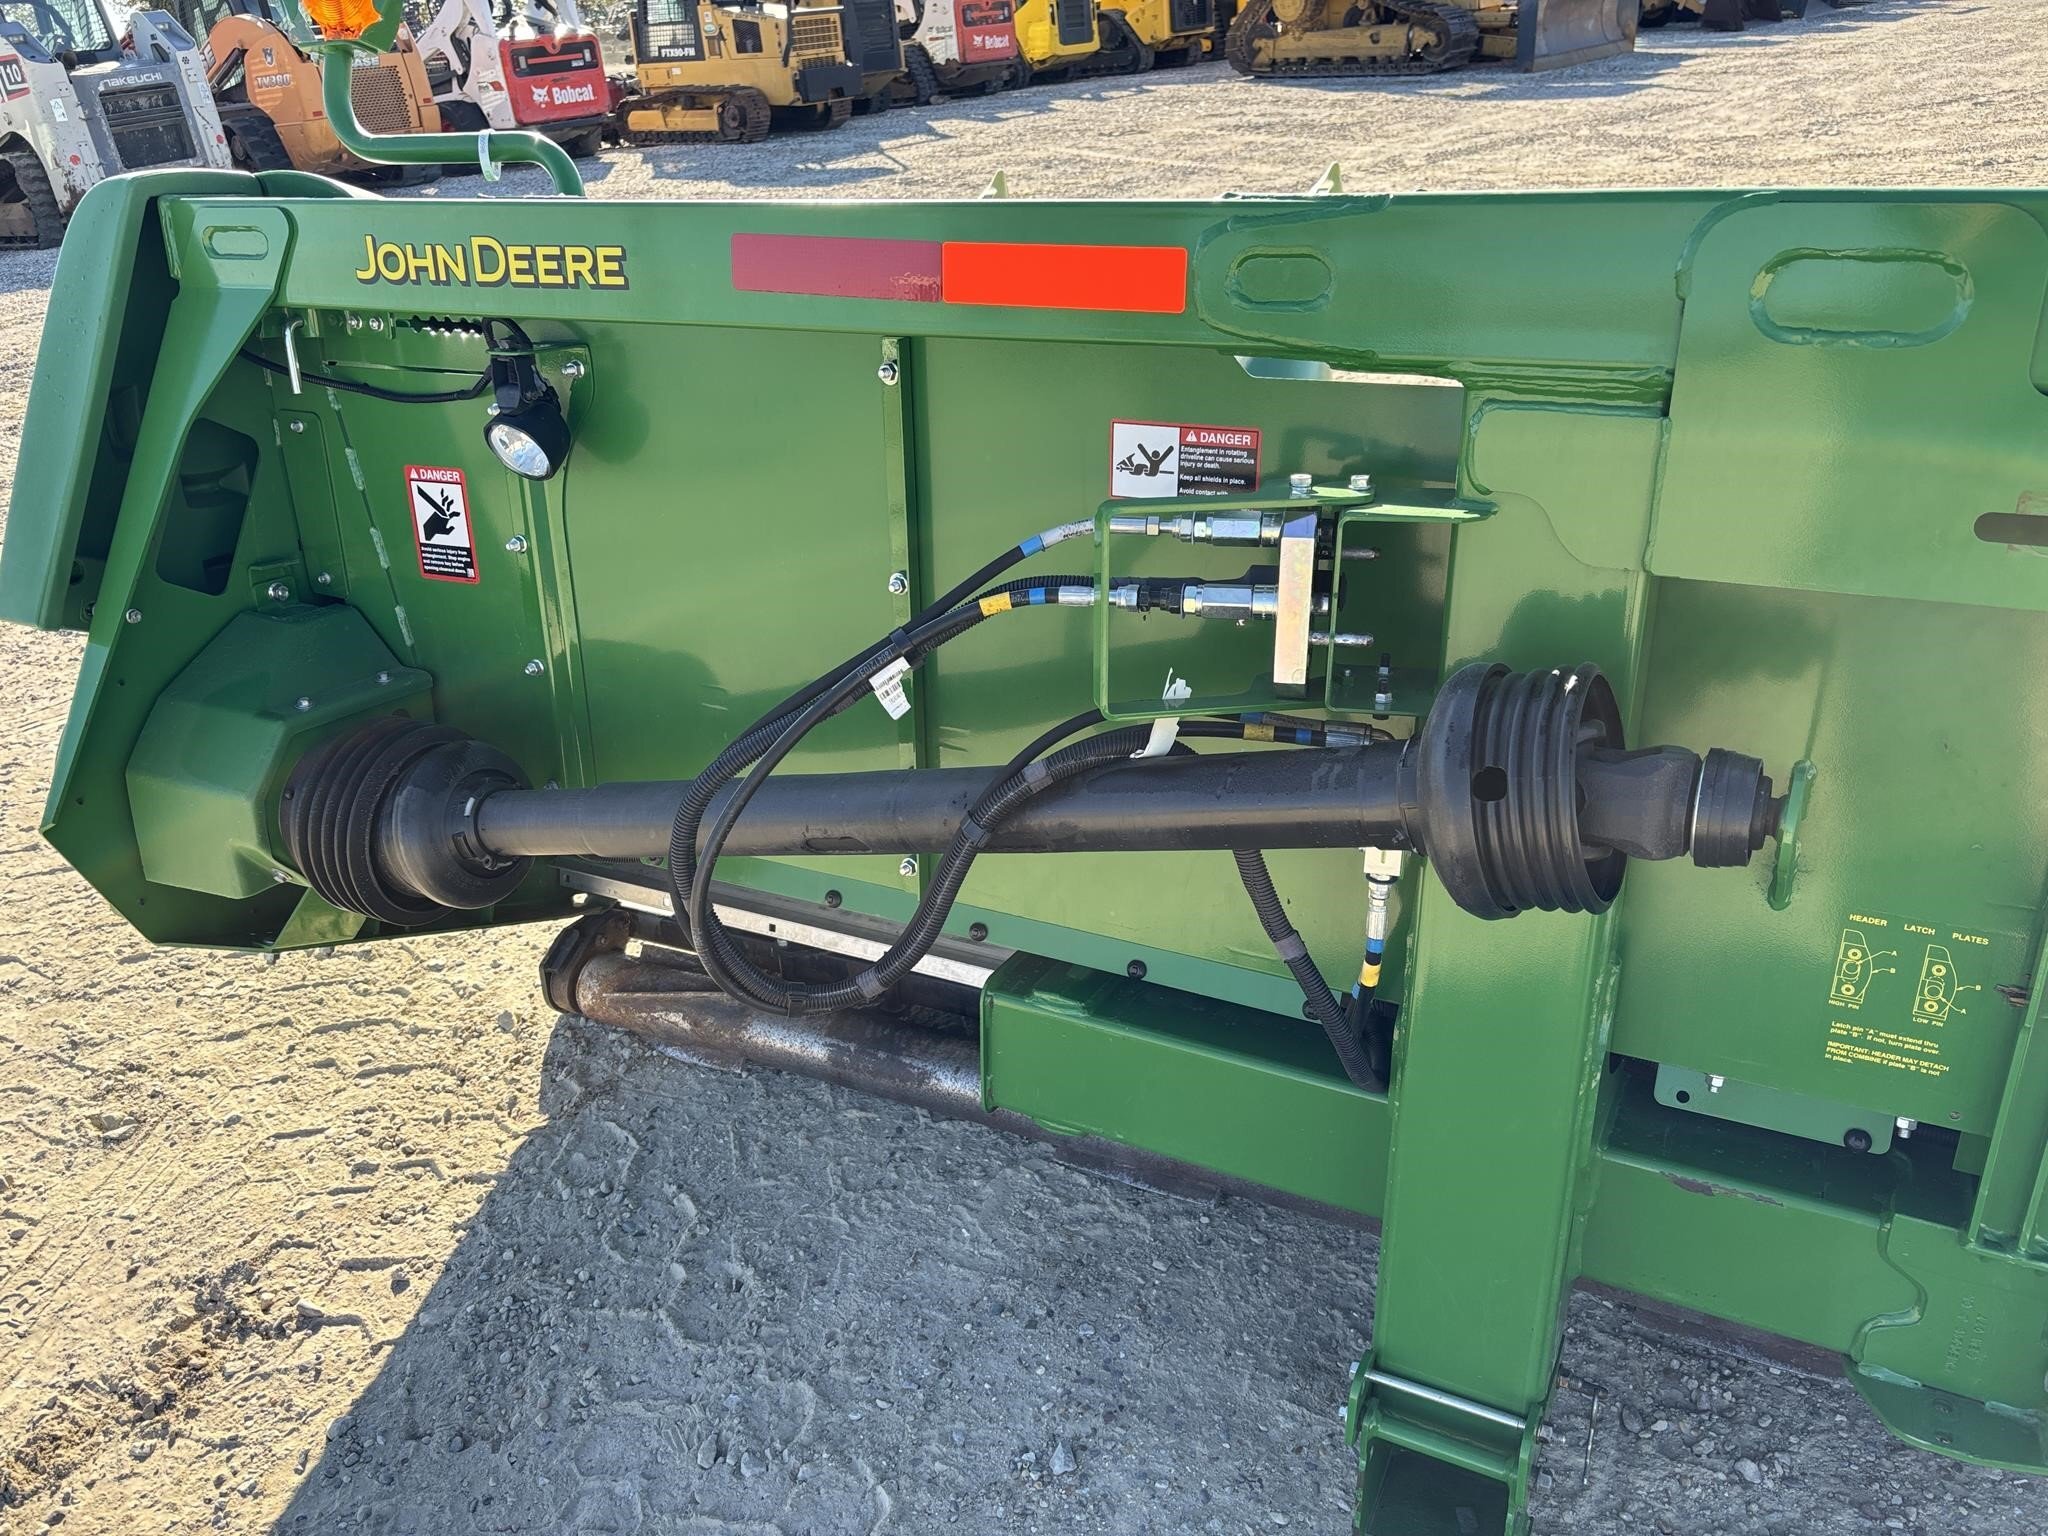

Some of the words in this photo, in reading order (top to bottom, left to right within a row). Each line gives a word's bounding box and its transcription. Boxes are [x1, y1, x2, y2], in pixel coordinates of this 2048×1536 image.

[985, 35, 1009, 49] Bobcat
[352, 57, 379, 68] ASE
[256, 73, 290, 88] TV380
[552, 84, 594, 104] Bobcat
[1200, 432, 1251, 445] DANGER
[1181, 446, 1217, 454] Entanglement
[420, 469, 460, 482] DANGER
[1180, 474, 1193, 482] Keep
[1849, 914, 1888, 927] HEADER
[1904, 924, 1936, 935] LATCH
[1952, 933, 1989, 945] PLATES
[1828, 999, 1845, 1007] HIGH
[1830, 1028, 1848, 1036] plate
[1873, 1037, 1886, 1045] not,
[1904, 1043, 1921, 1052] plate
[1831, 1021, 1851, 1030] Latch
[1898, 1035, 1923, 1044] extend
[1924, 1040, 1939, 1048] thru
[1826, 1047, 1847, 1055] FROM
[1848, 1051, 1881, 1064] COMBINE
[1888, 1061, 1905, 1069] plate
[1928, 1069, 1940, 1077] not
[1827, 1041, 1870, 1055] IMPORTANT:
[1871, 1051, 1901, 1062] HEADER
[1902, 1057, 1918, 1065] MAY
[1920, 1060, 1949, 1071] DETACH
